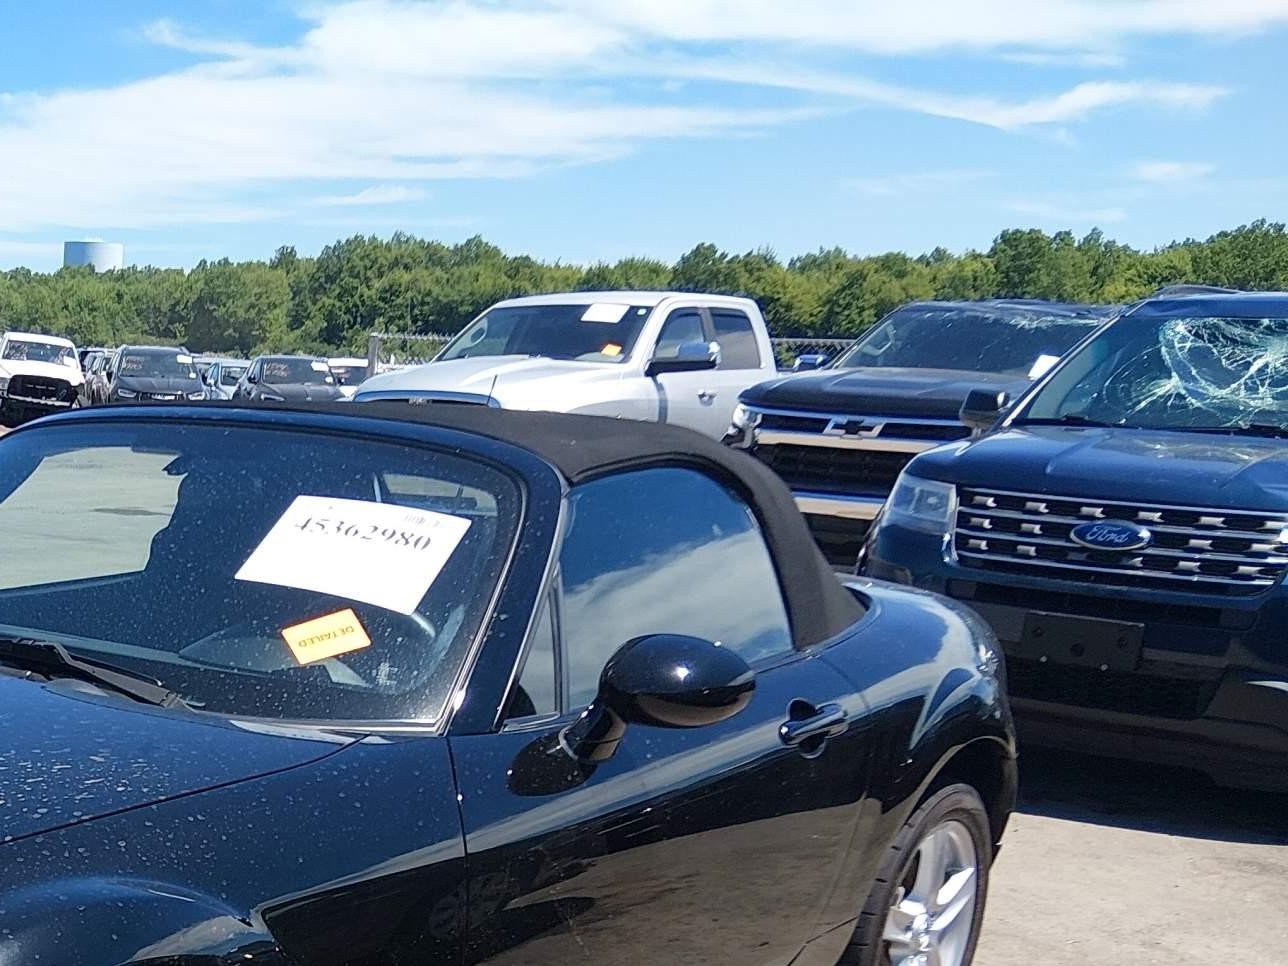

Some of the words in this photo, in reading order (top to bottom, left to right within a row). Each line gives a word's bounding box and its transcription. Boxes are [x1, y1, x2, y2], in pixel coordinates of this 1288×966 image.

[295, 517, 431, 550] 45362980
[1086, 526, 1130, 543] Ford
[298, 625, 355, 648] DETAILED
